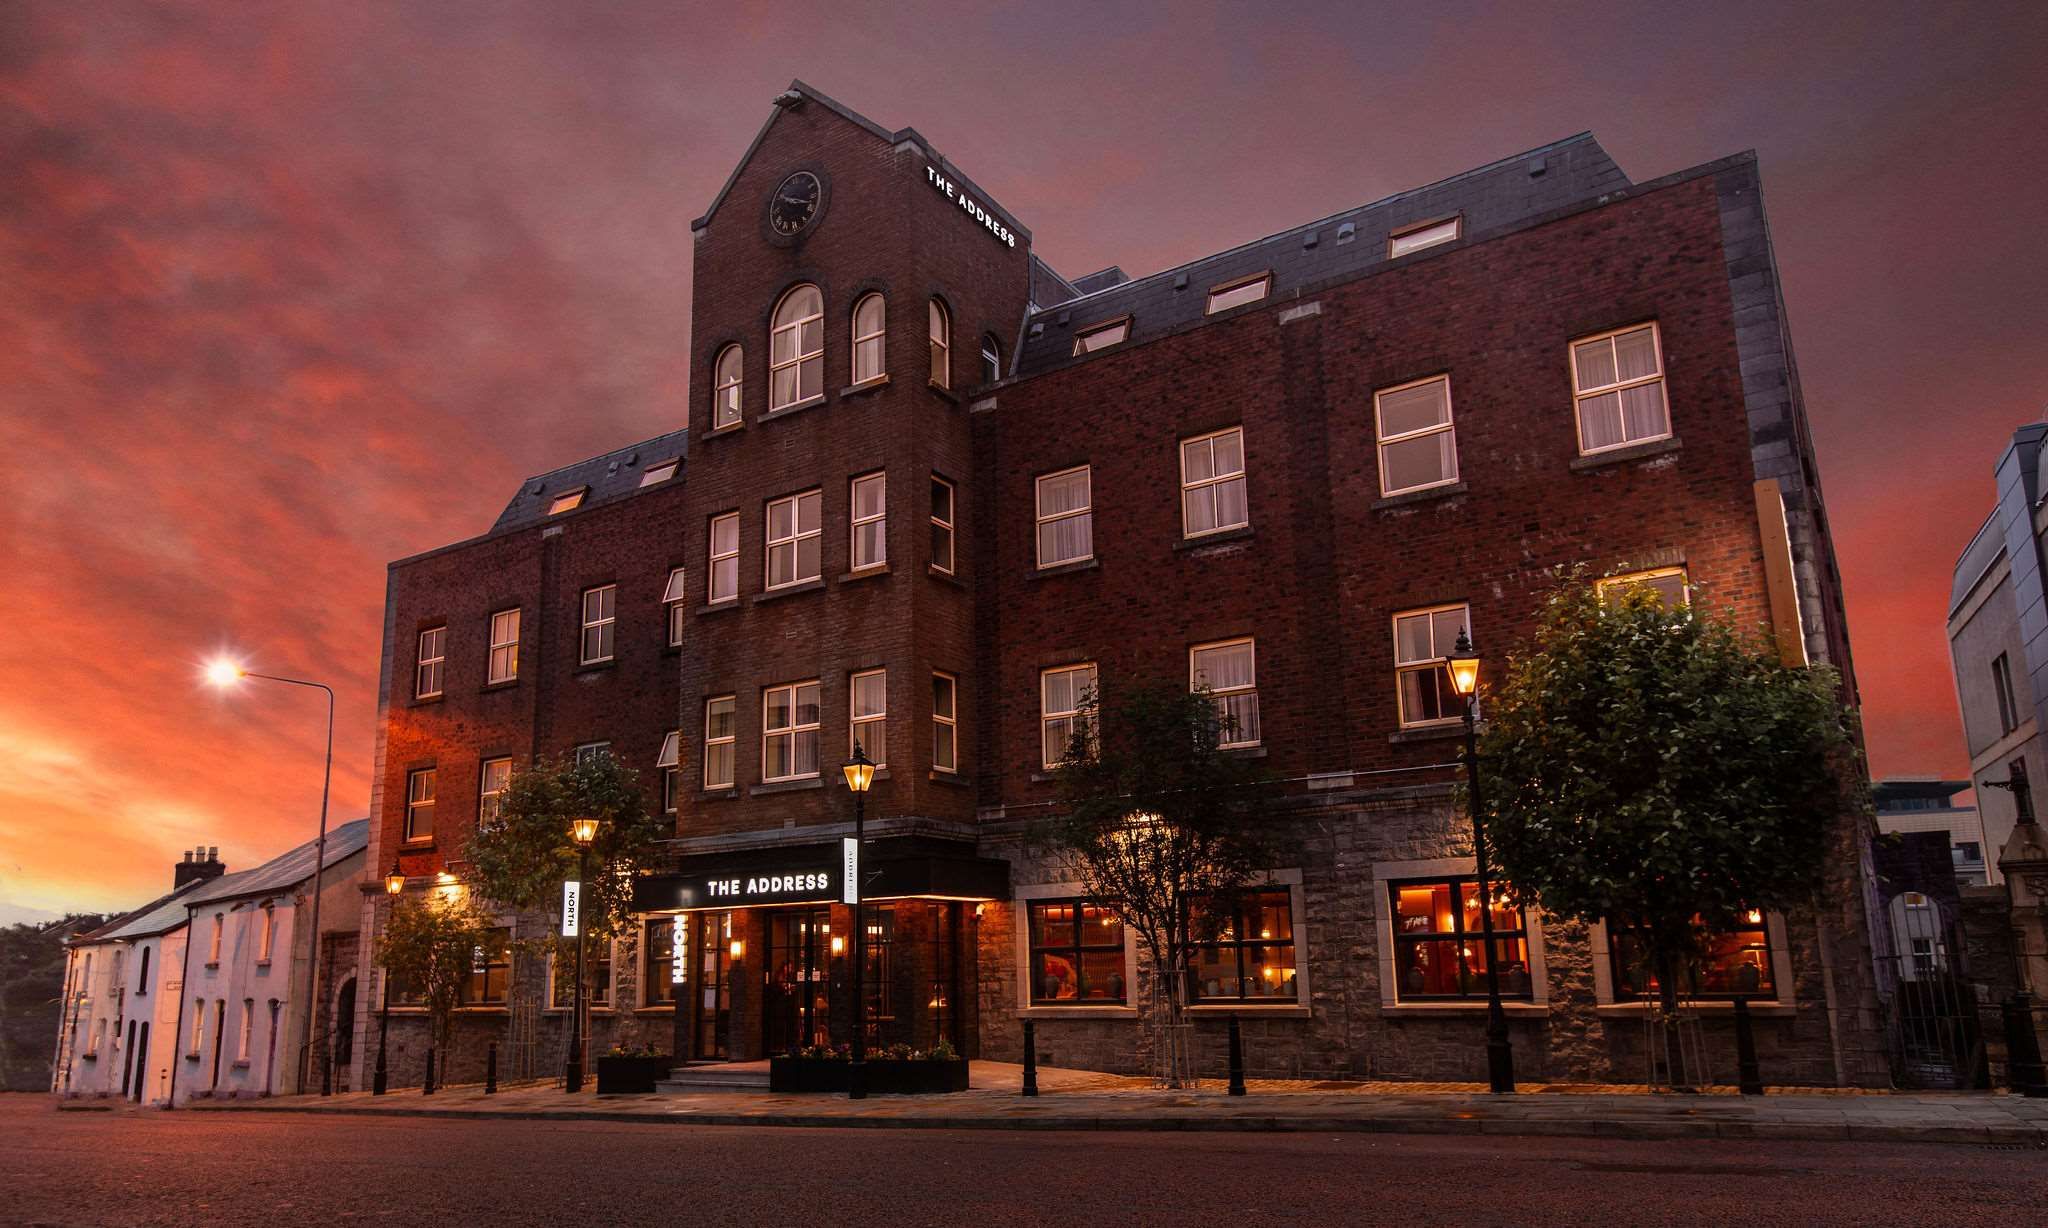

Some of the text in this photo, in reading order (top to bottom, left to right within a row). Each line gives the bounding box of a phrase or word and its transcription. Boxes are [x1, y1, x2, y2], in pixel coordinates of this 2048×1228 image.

[927, 166, 1015, 248] THE ADDRESS
[567, 891, 576, 927] NORTH
[708, 873, 829, 896] THE ADDRESS
[672, 915, 688, 984] NORTH
